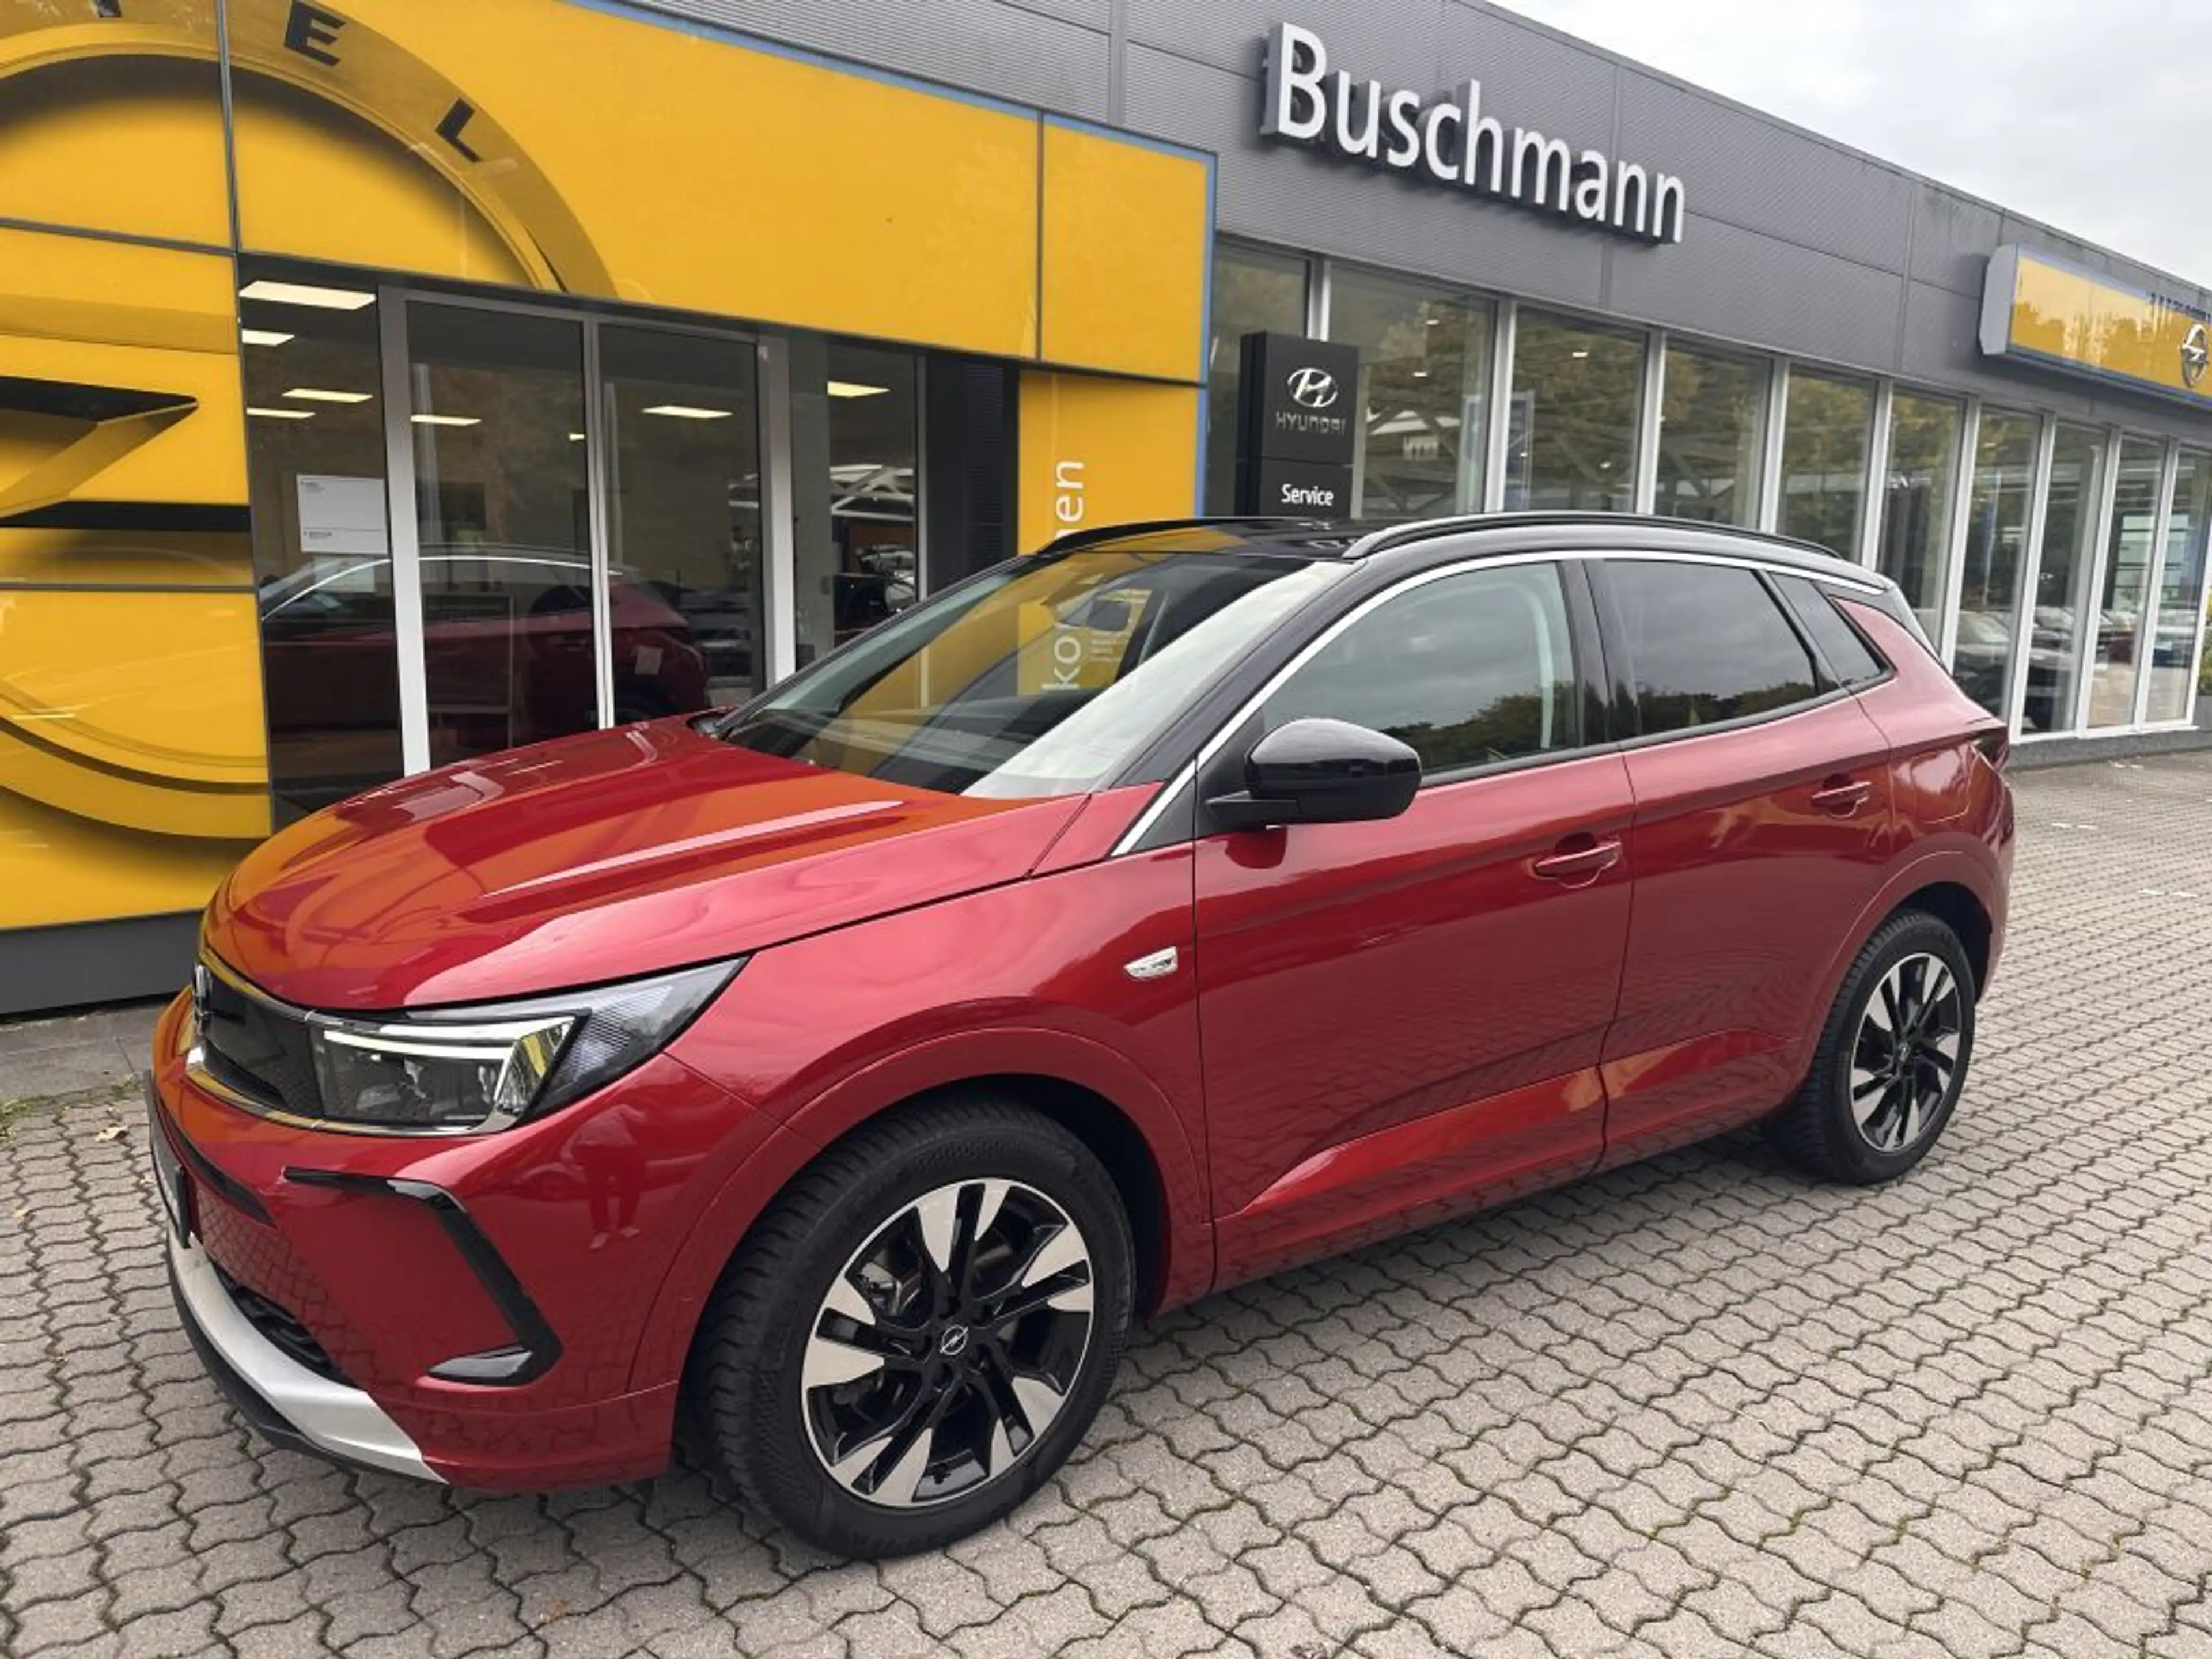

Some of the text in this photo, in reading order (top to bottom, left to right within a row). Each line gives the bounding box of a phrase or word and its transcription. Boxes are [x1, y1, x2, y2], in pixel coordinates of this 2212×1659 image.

[1277, 22, 1686, 244] Buschmann
[1275, 411, 1346, 435] HYUNDAI
[1281, 483, 1334, 506] Service
